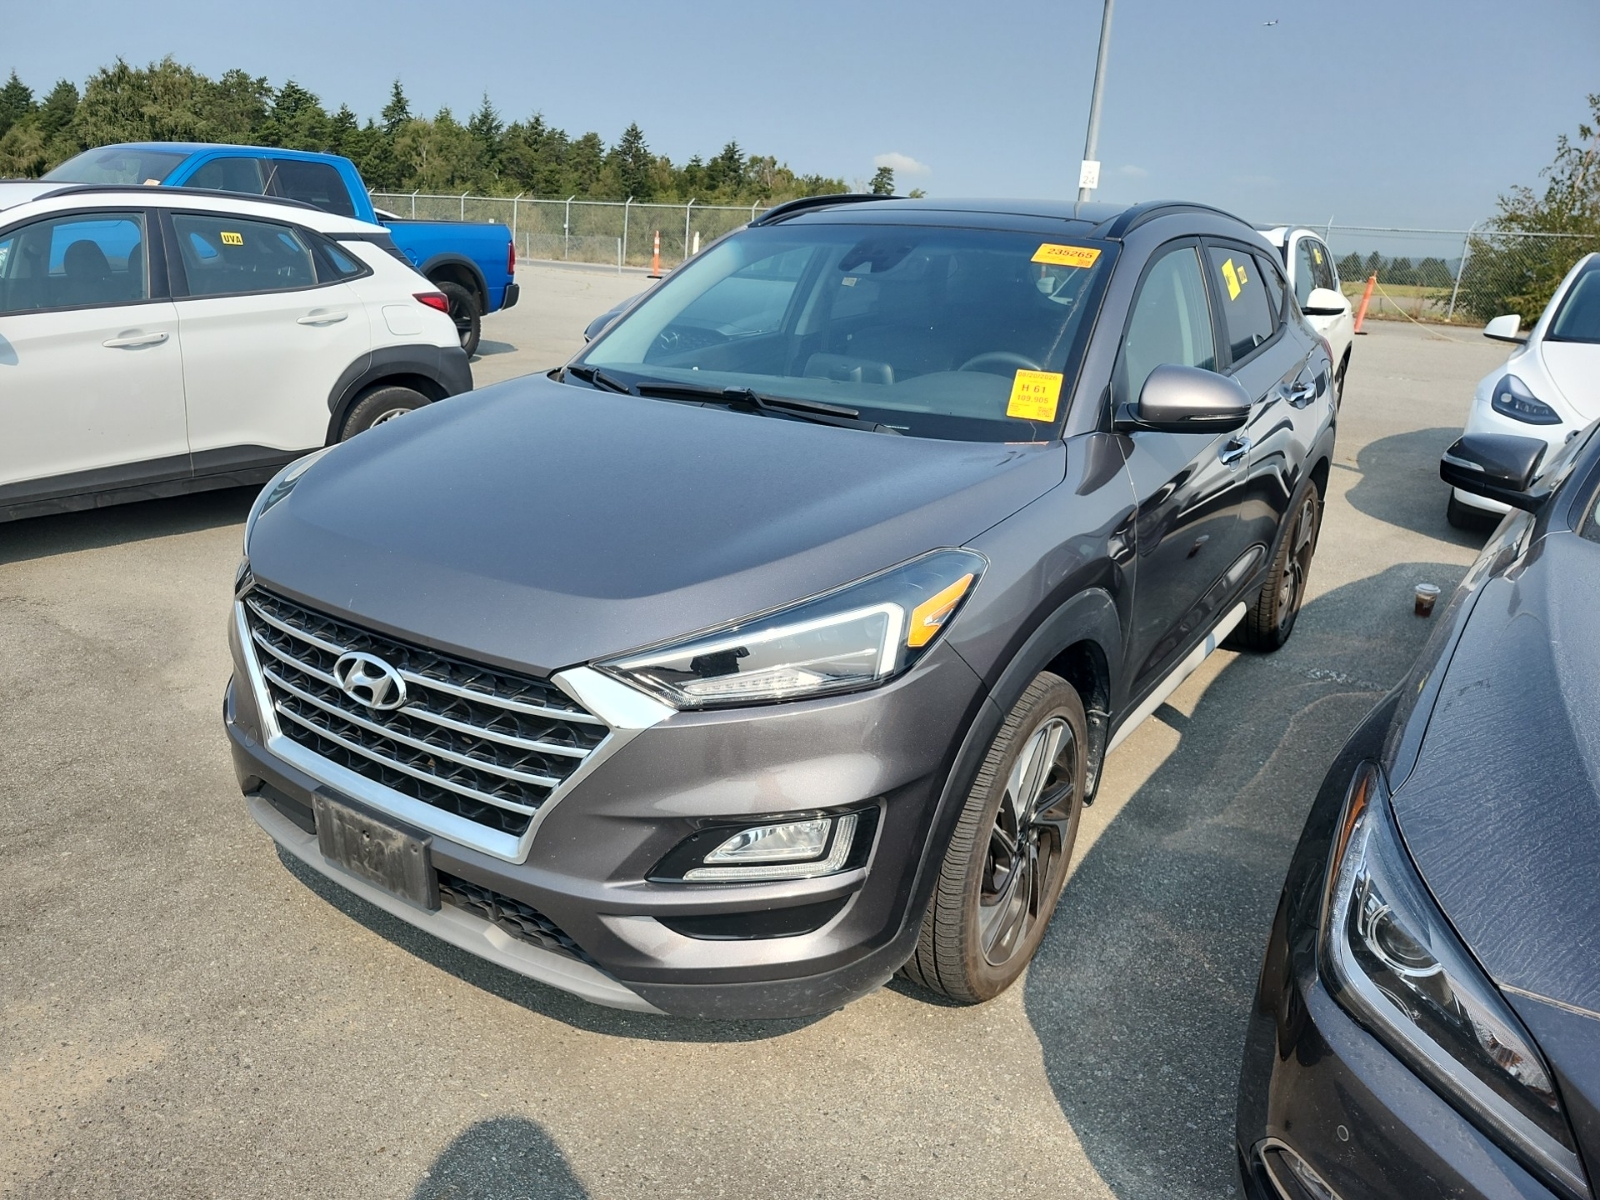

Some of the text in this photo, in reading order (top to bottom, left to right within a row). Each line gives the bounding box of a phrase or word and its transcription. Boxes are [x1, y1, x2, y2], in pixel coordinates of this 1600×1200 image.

[1082, 175, 1095, 185] 24
[223, 234, 242, 243] UVA
[1047, 248, 1093, 258] 235265
[1021, 384, 1046, 394] H 61
